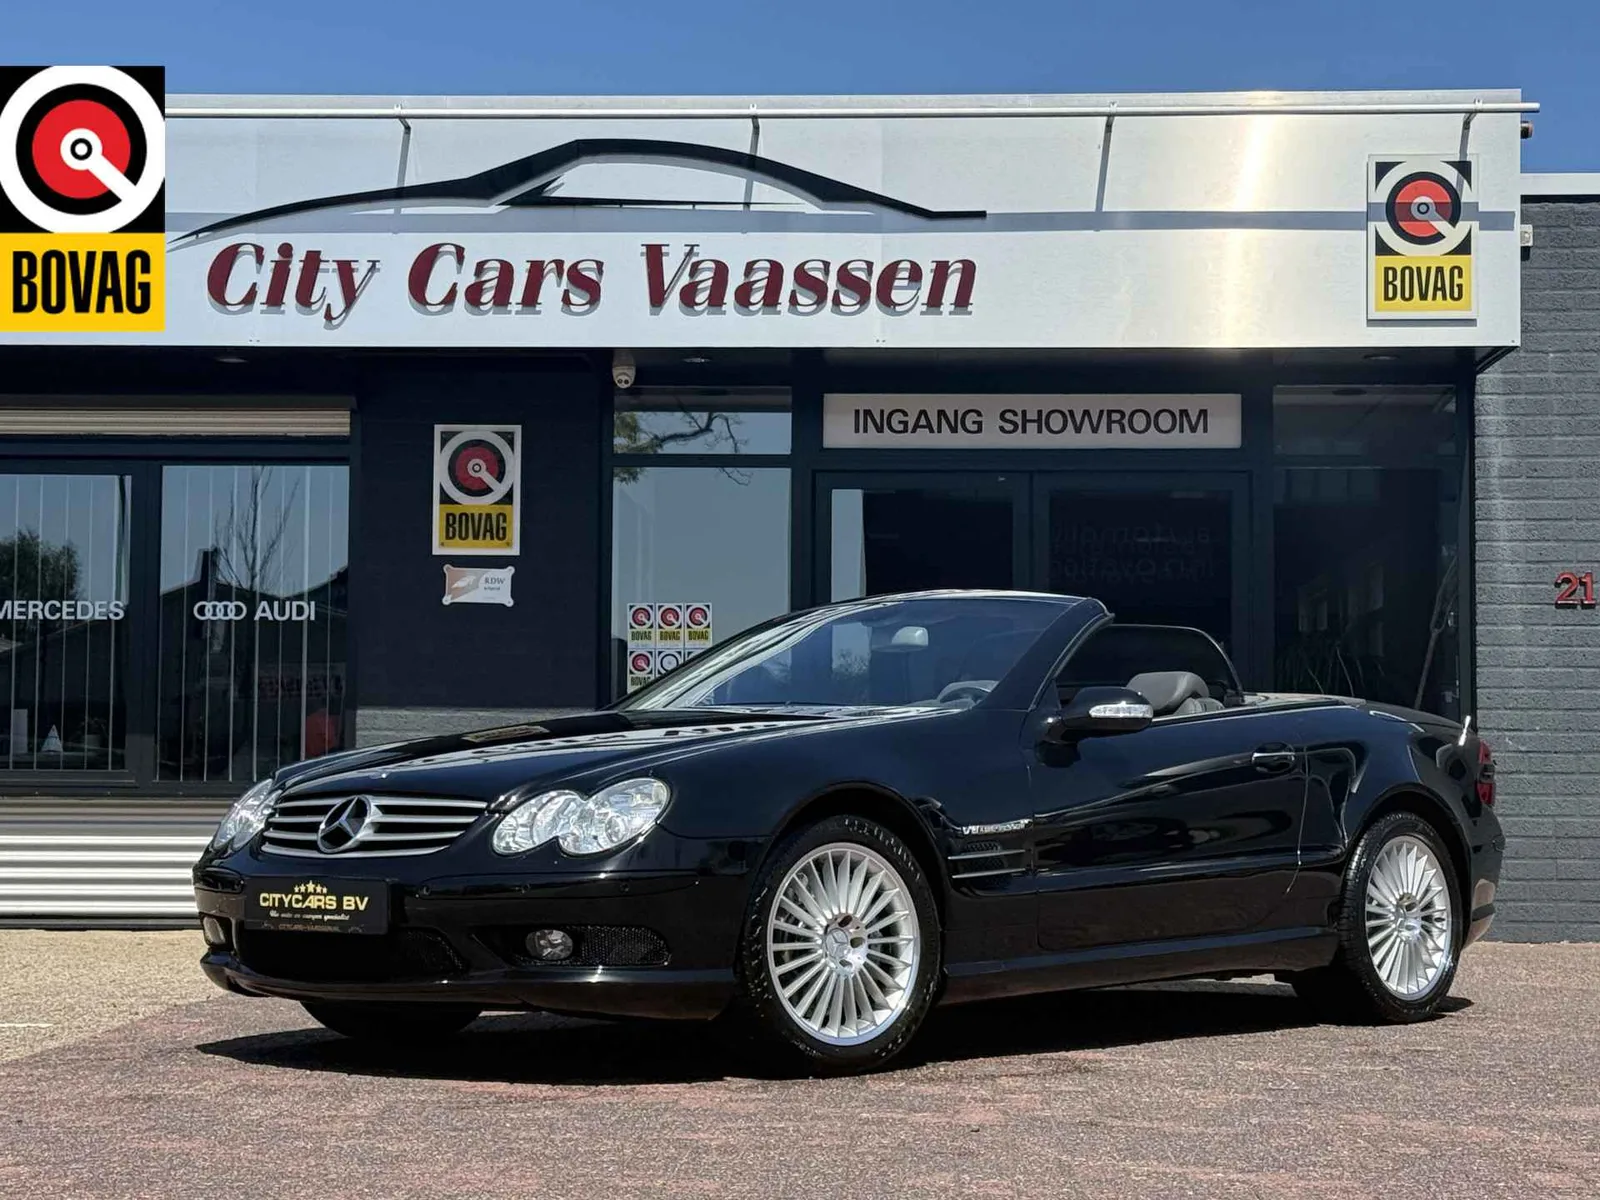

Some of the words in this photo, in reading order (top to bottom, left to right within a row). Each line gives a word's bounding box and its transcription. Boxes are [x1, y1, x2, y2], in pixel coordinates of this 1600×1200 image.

[206, 242, 380, 322] City
[407, 242, 604, 310] Cars
[640, 243, 976, 310] Vaassen
[1383, 265, 1464, 302] BOVAG
[853, 407, 983, 435] INGANG
[998, 407, 1209, 435] SHOWROOM
[445, 512, 507, 542] BOVAG
[484, 576, 506, 585] RDW
[1554, 571, 1596, 607] 21
[253, 600, 315, 621] AUDI
[631, 630, 652, 641] BOVAG
[659, 630, 680, 641] BOVAG
[688, 630, 709, 641] BOVAG
[259, 892, 337, 910] CITYCARS
[342, 896, 370, 911] BV
